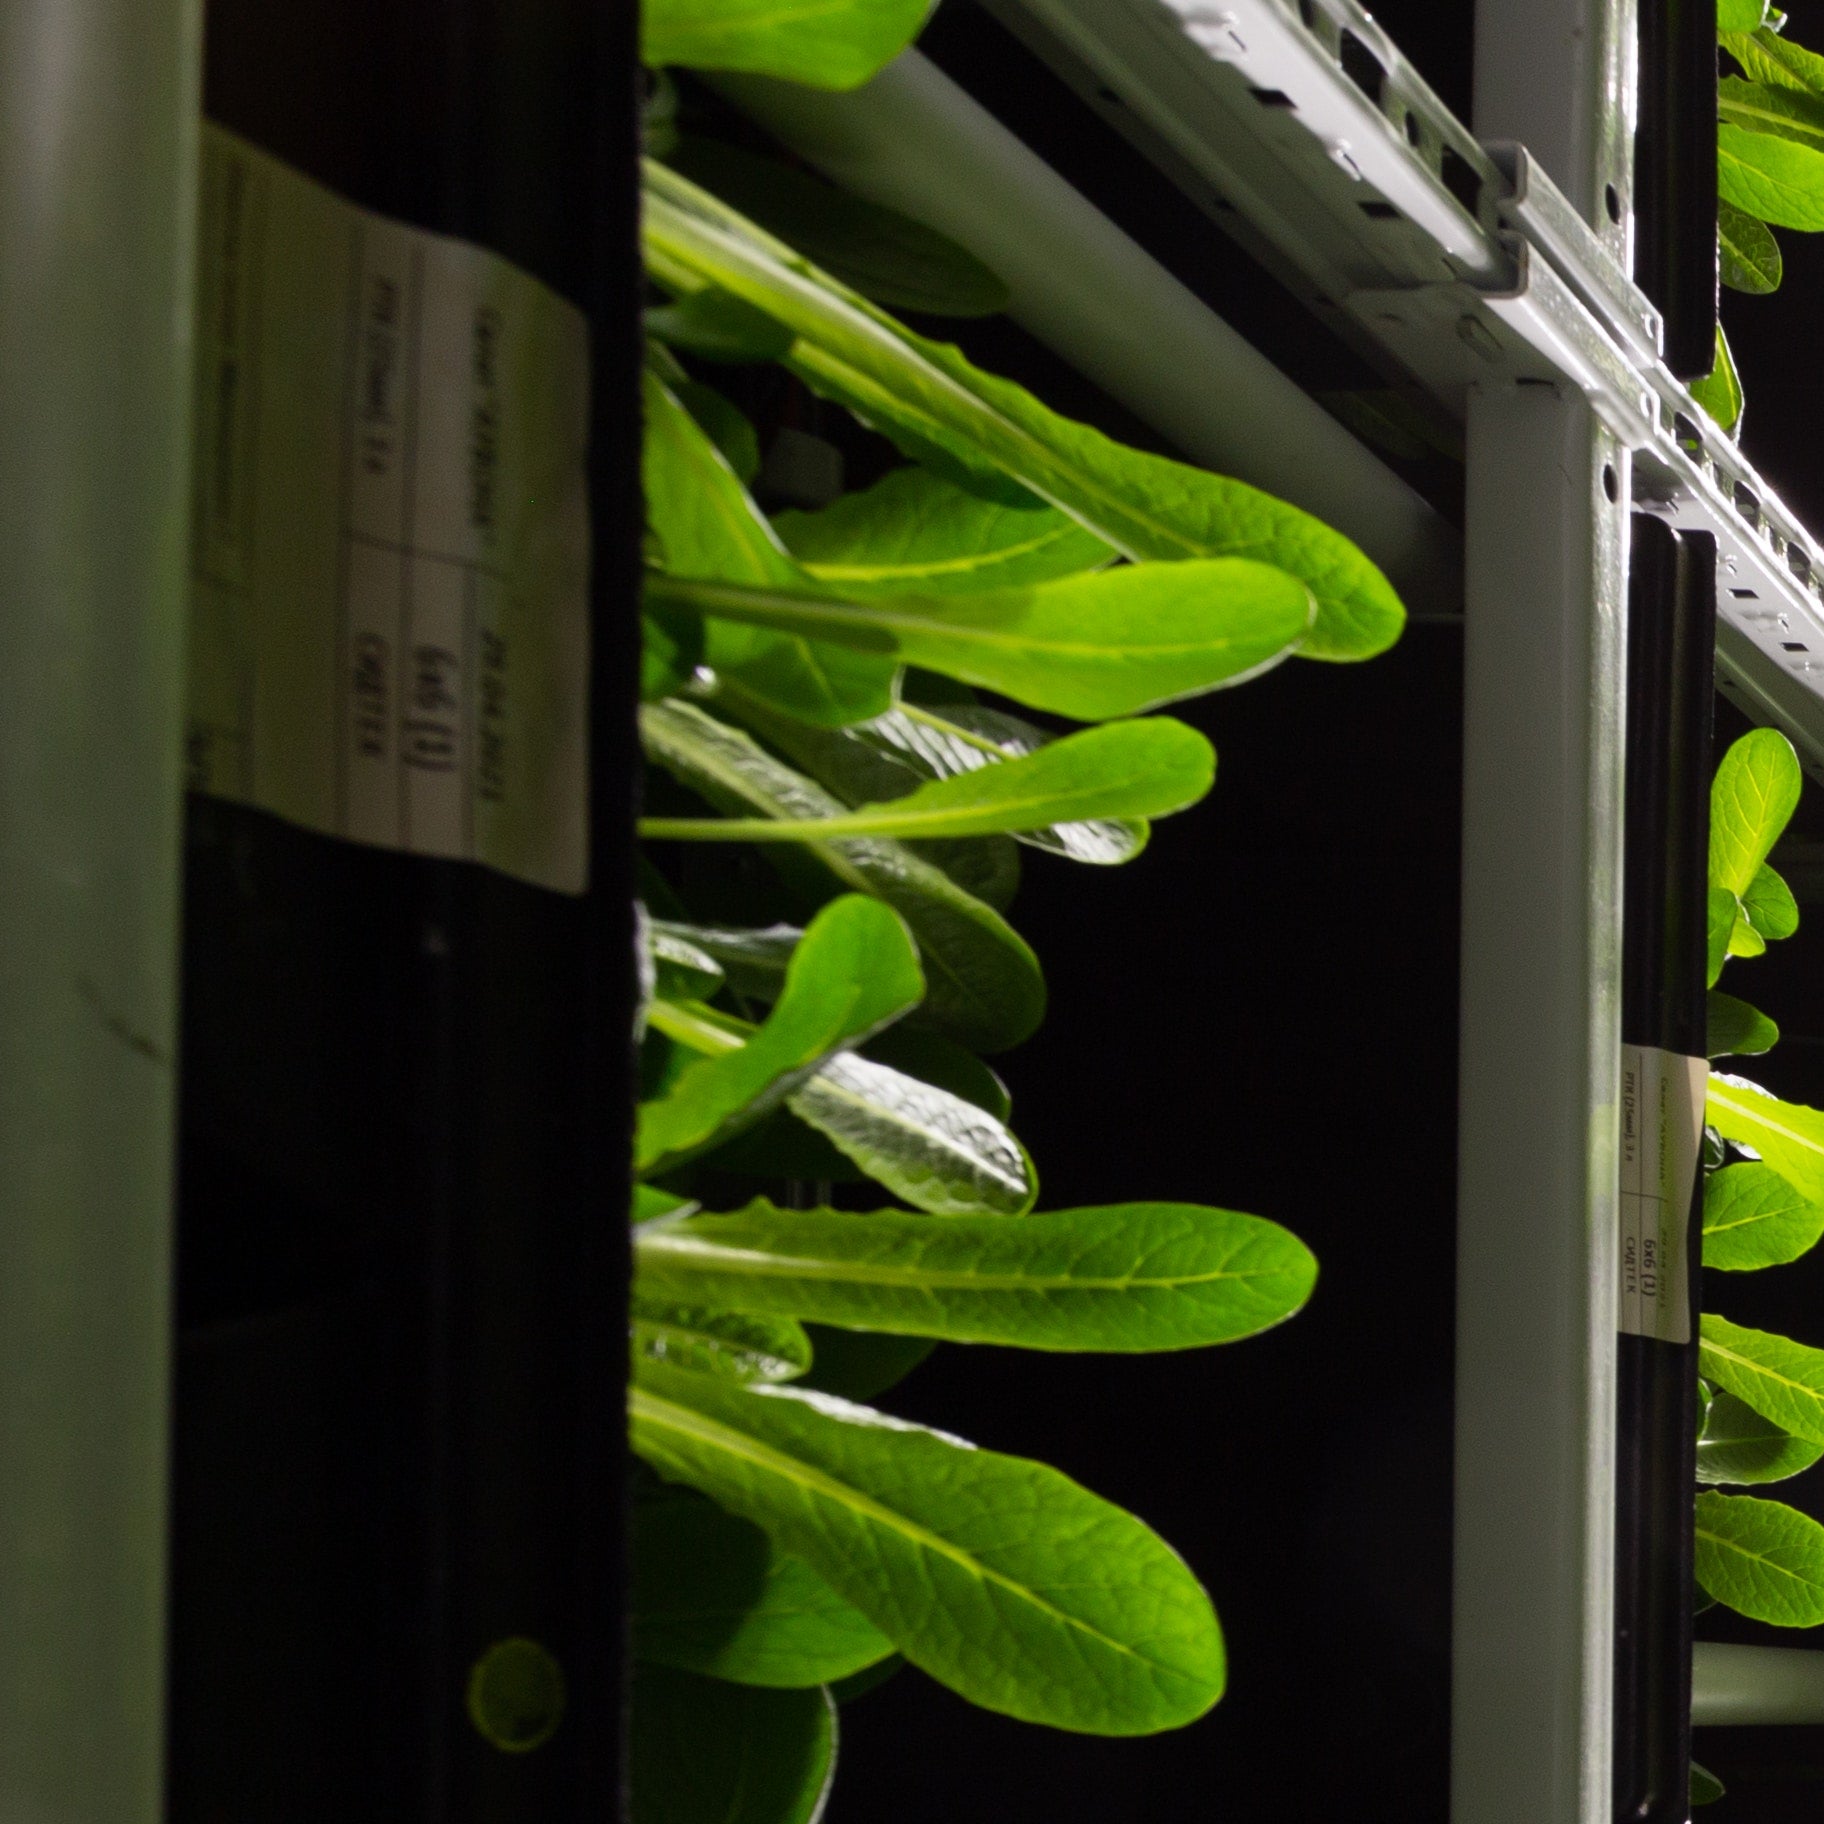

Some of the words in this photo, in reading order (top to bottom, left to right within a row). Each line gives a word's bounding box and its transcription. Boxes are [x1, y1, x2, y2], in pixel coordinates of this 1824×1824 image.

[1625, 1236, 1637, 1294] СИДТЕК
[1643, 1238, 1656, 1269] 6x6
[1640, 1273, 1657, 1297] (1)
